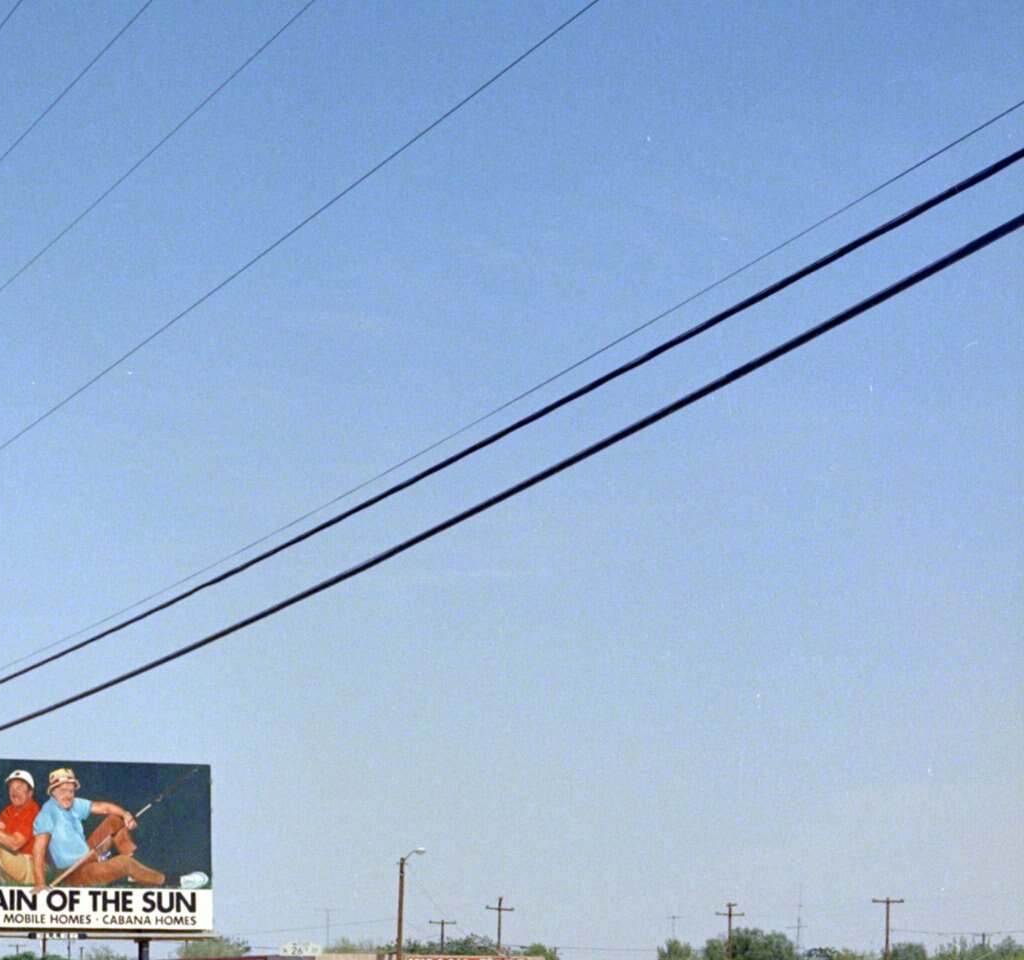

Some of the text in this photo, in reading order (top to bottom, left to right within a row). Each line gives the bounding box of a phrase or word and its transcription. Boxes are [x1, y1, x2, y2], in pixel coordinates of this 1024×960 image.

[46, 890, 80, 912] OF
[89, 891, 133, 912] THE
[139, 891, 196, 913] SUN
[3, 913, 46, 924] MOBILE
[50, 914, 91, 925] HOMES
[102, 914, 151, 925] CABANA
[155, 915, 197, 926] HOMES
